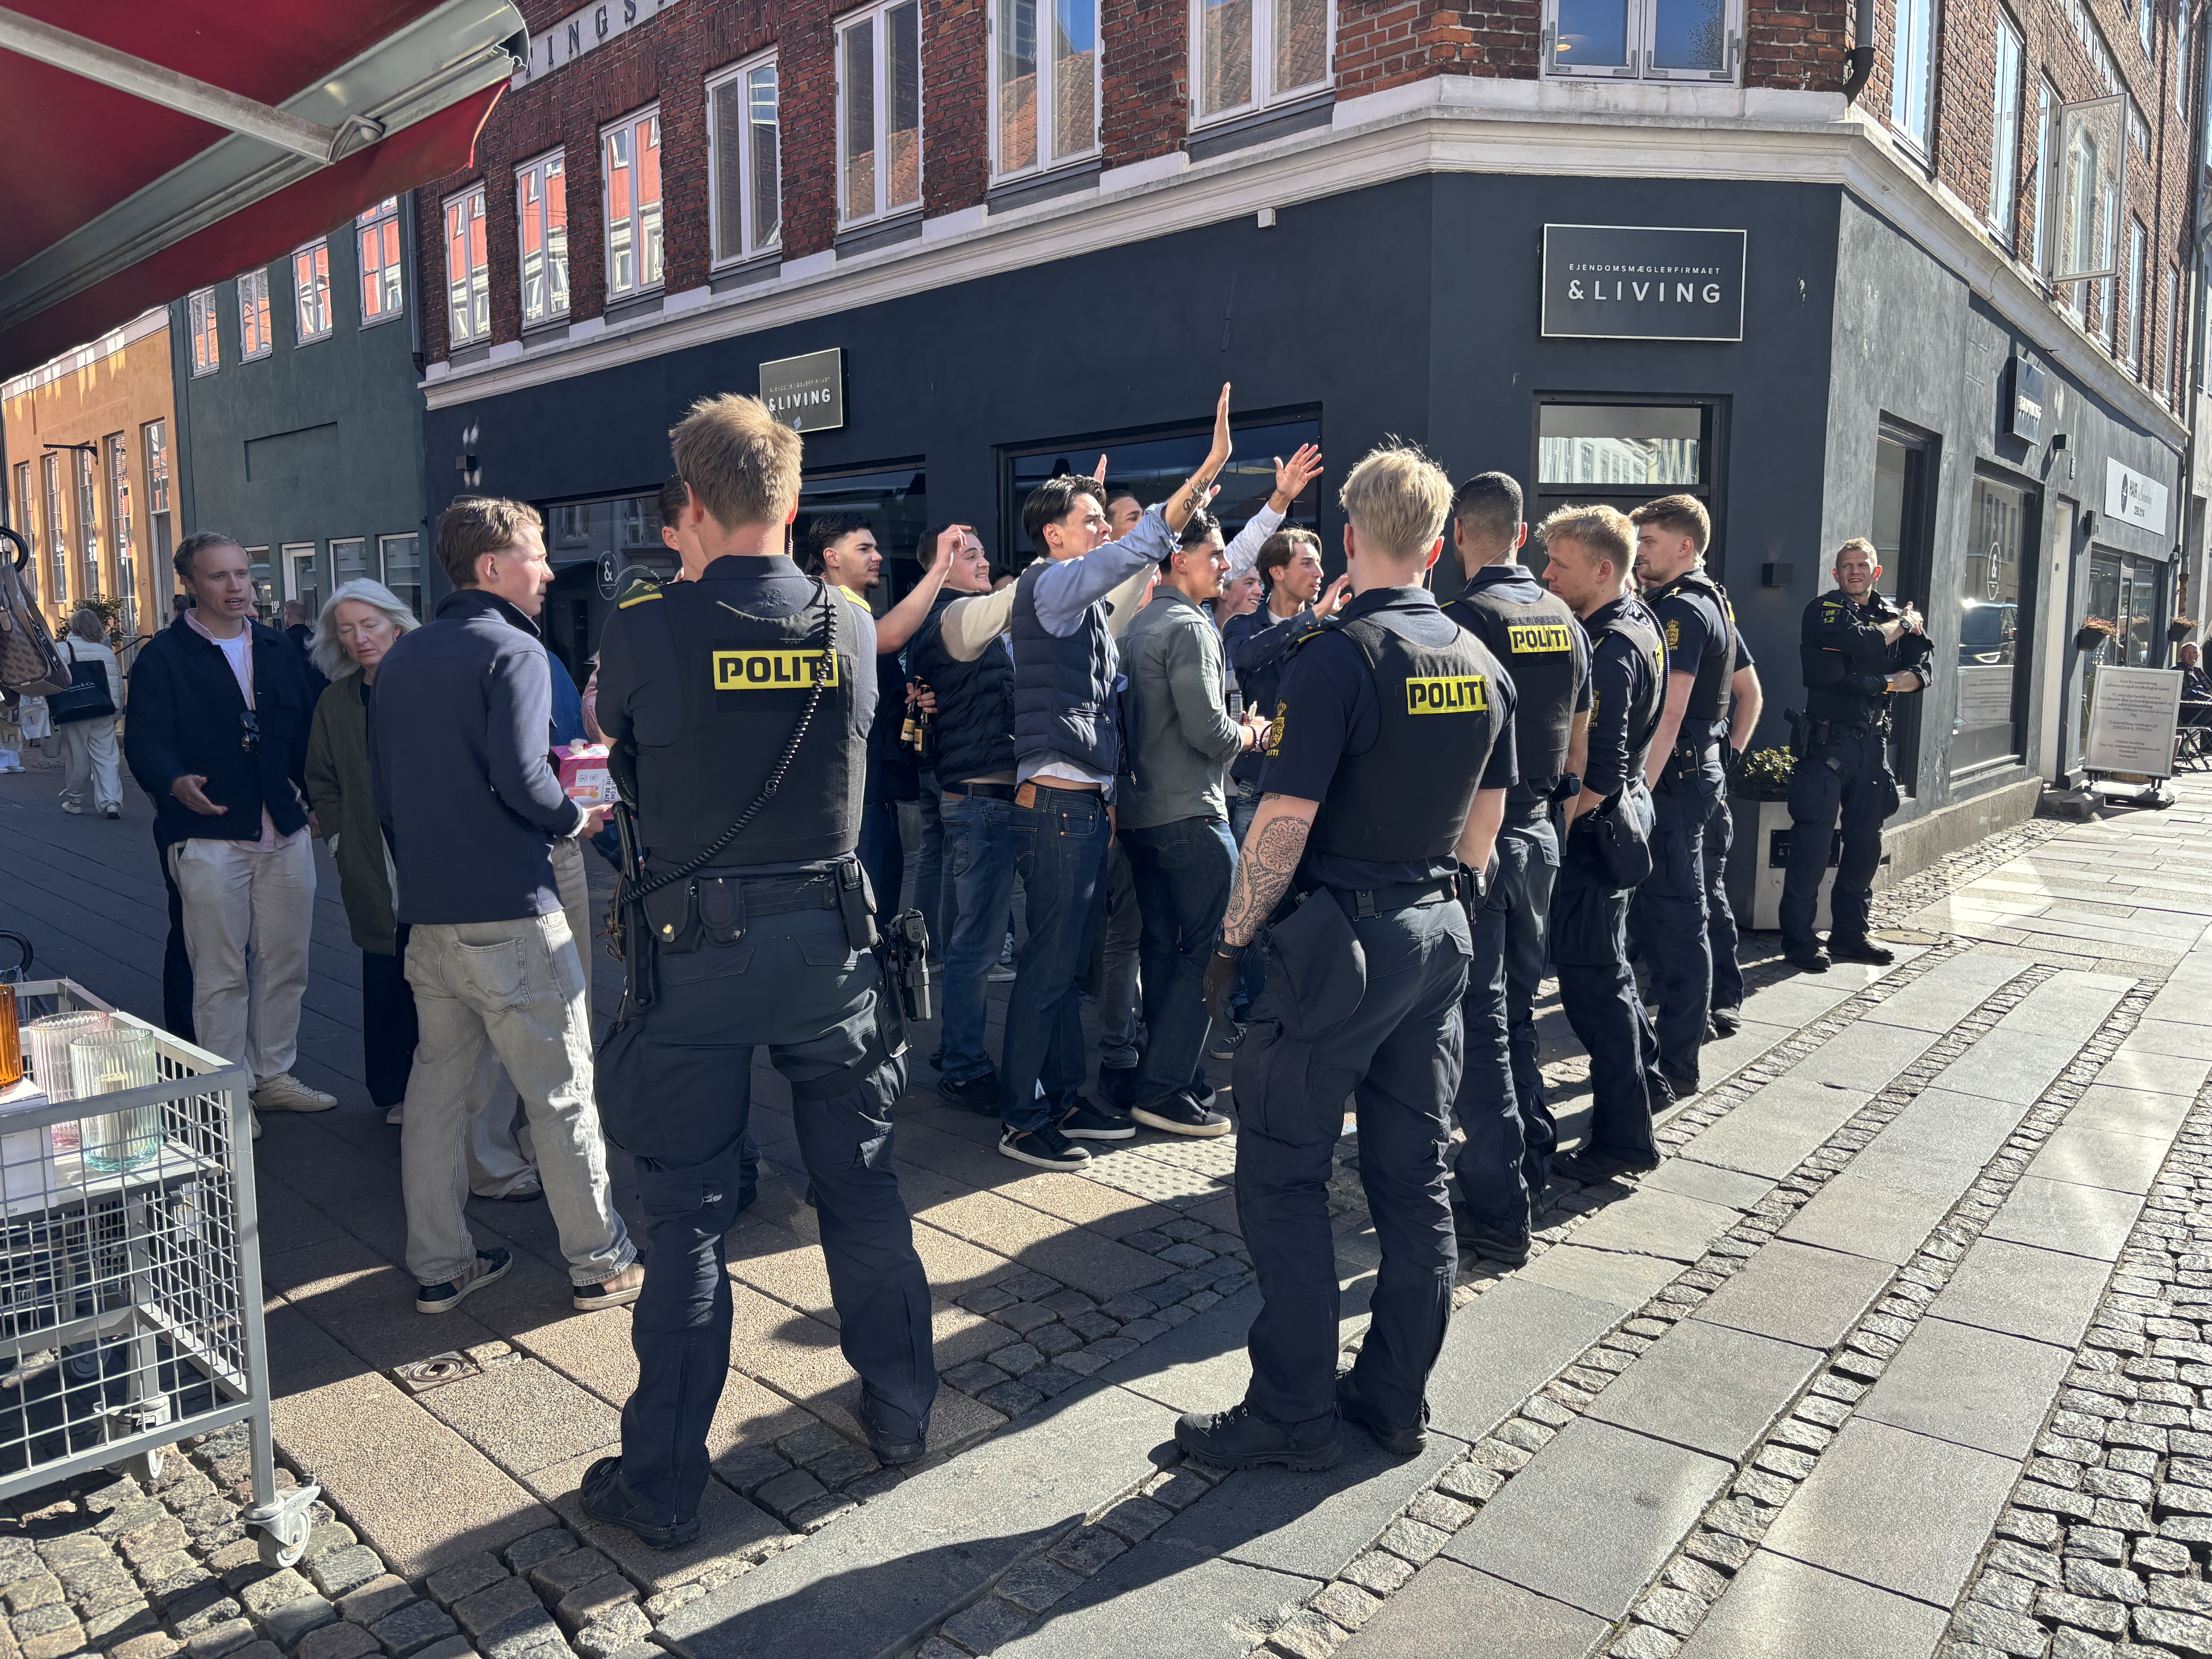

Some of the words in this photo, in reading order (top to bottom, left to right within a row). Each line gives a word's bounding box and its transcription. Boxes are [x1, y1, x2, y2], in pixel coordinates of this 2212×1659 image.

[526, 0, 664, 77] INGS
[1569, 264, 1720, 274] EJENDOMSMÆGLERFIRMAET
[1512, 630, 1569, 649] POLITI
[719, 656, 834, 683] POLITI
[1409, 681, 1487, 709] POLITI
